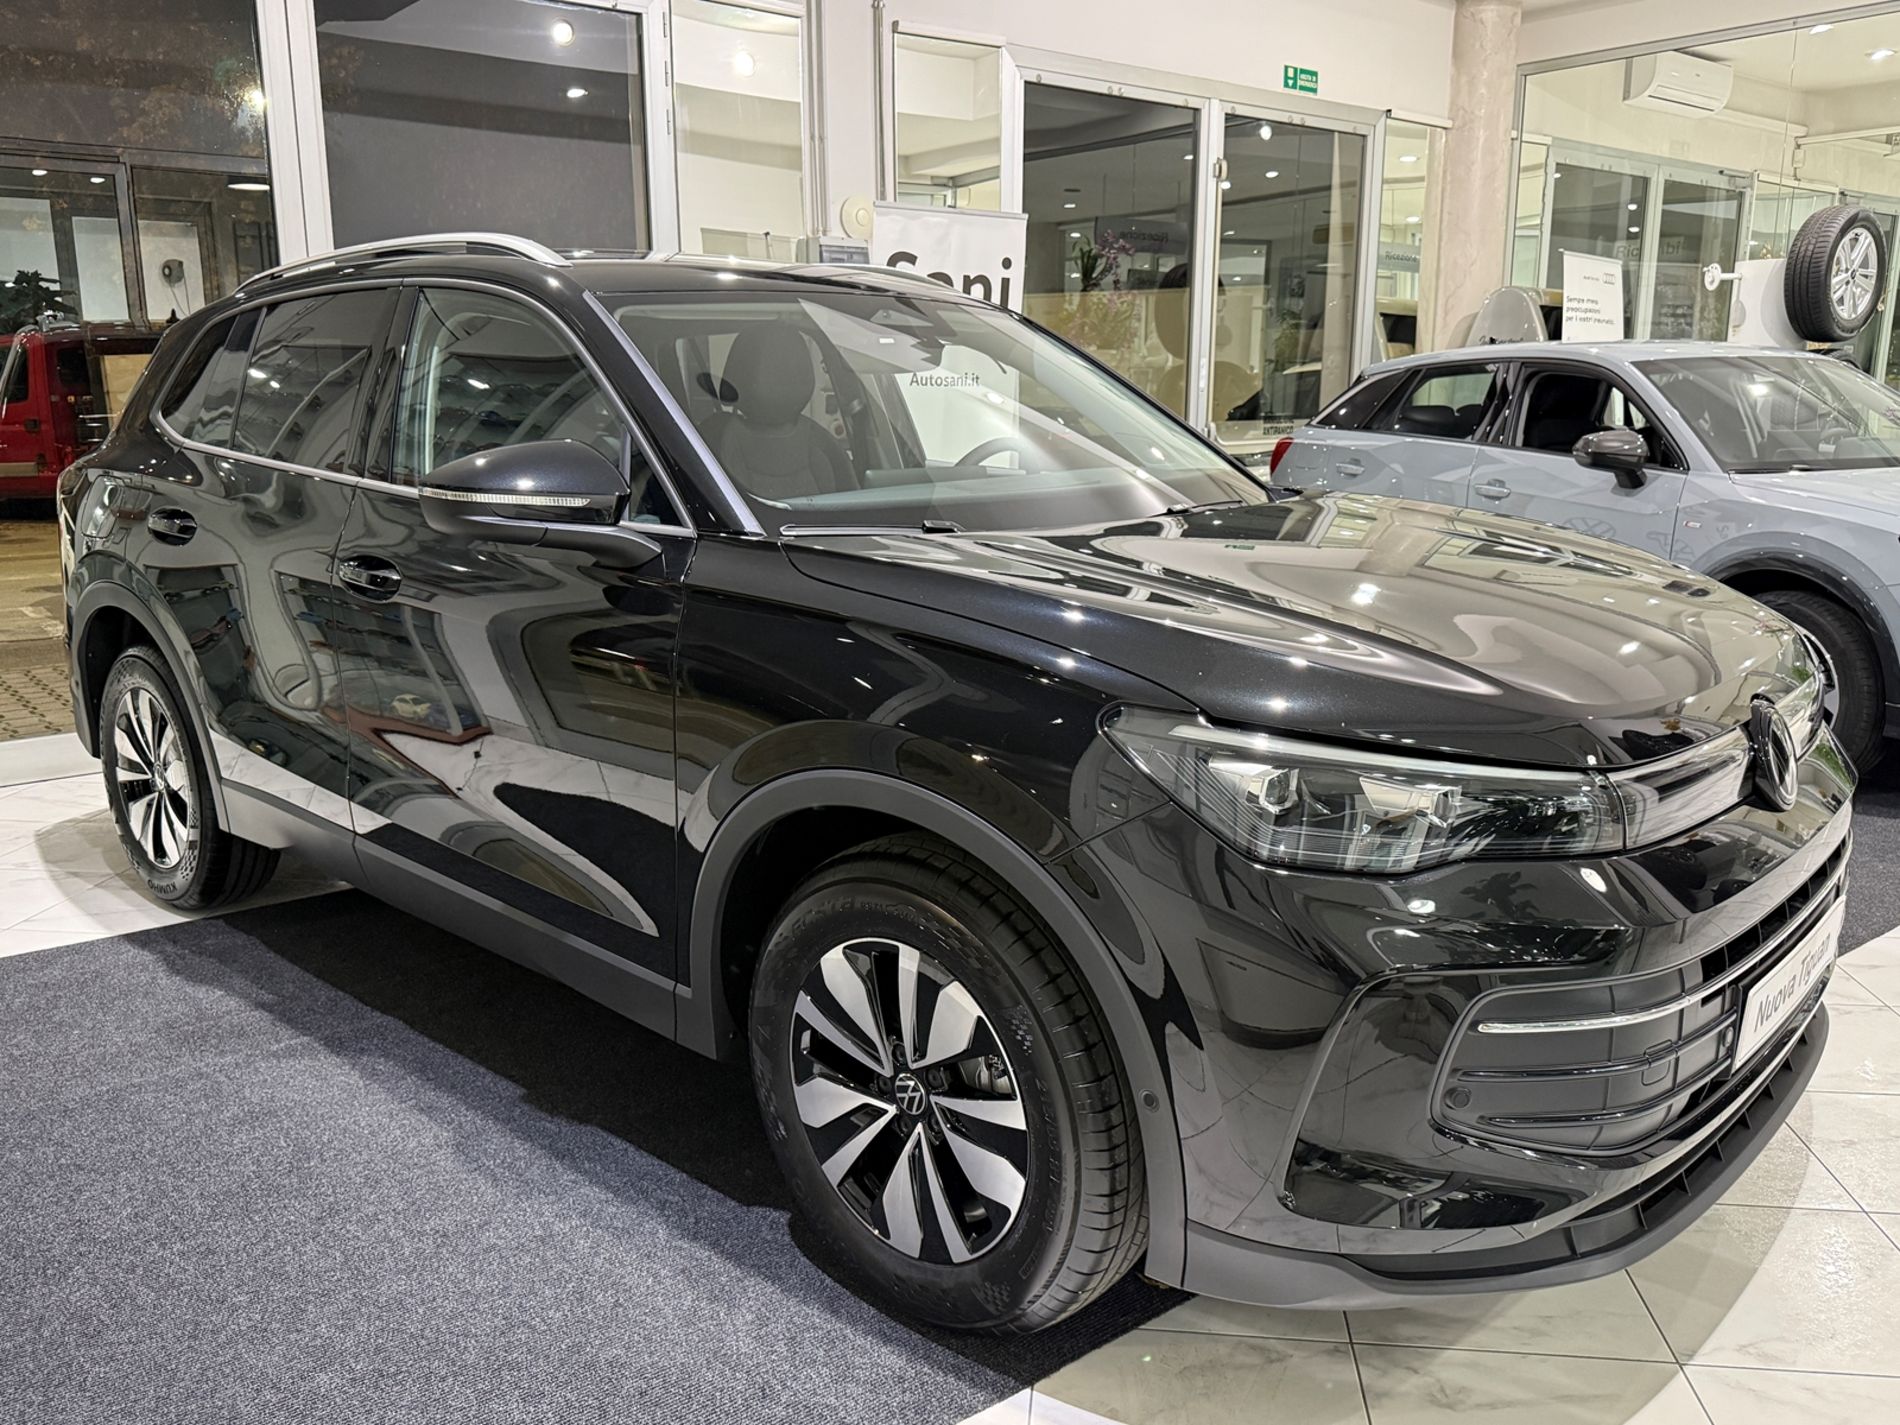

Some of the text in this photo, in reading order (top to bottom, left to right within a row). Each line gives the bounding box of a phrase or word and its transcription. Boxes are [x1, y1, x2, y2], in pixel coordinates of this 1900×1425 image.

[909, 372, 980, 387] Autosani.it
[147, 879, 177, 894] KUMHO
[1754, 973, 1797, 1033] Nuova
